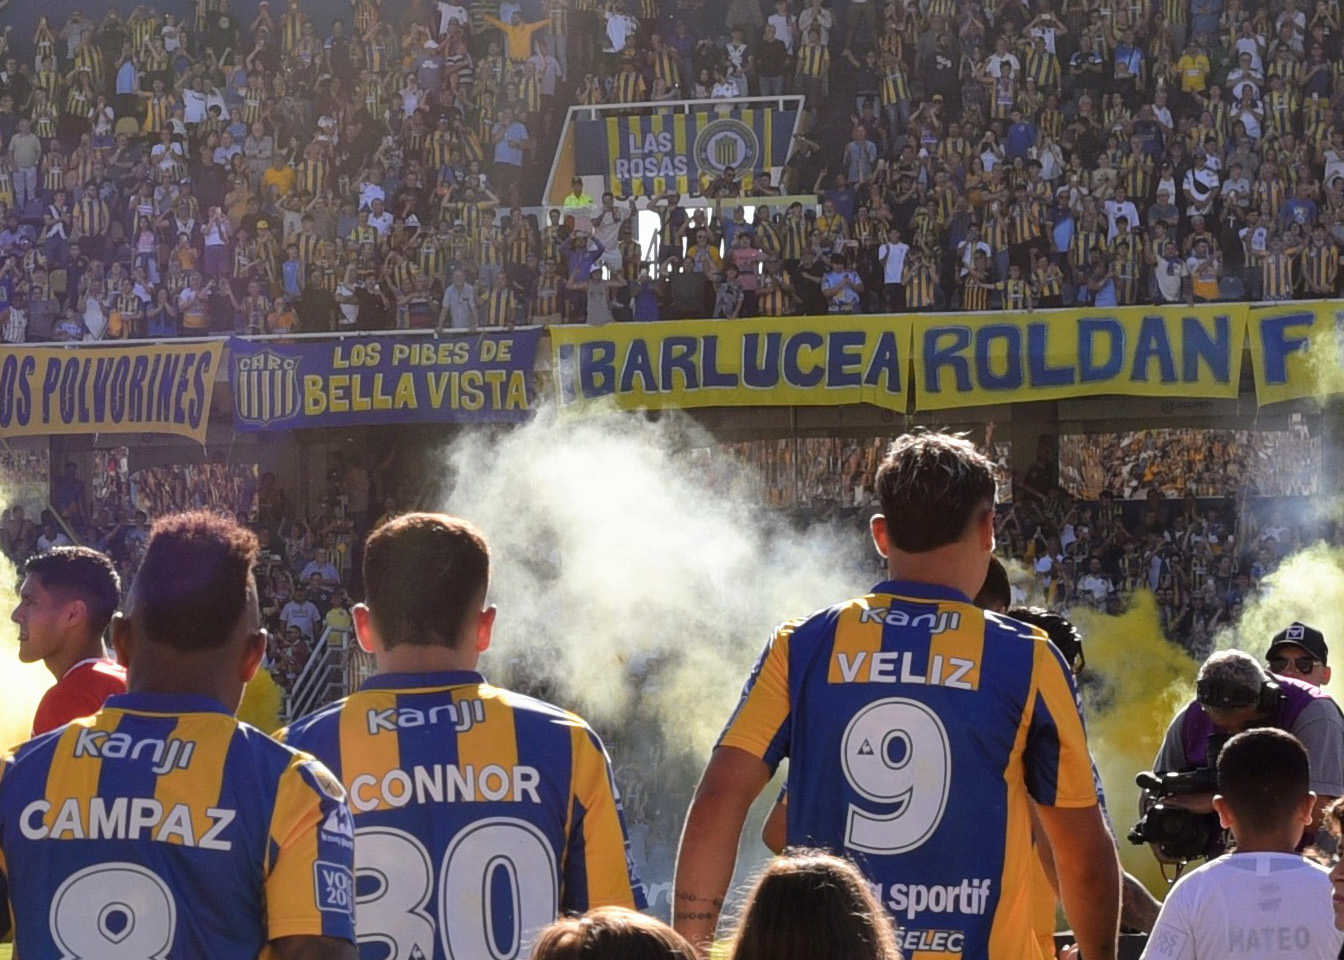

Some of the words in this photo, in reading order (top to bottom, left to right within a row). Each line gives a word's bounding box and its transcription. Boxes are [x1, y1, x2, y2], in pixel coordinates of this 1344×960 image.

[629, 132, 672, 154] LAS
[616, 156, 688, 179] ROSAS
[333, 342, 381, 368] LOS
[393, 339, 469, 366] PIBES
[479, 340, 513, 362] DE
[922, 314, 1231, 392] ROLDAN
[42, 351, 212, 430] POLVORINES
[304, 372, 418, 415] BELLA
[427, 370, 529, 410] VISTA
[837, 652, 974, 690] VELIZ
[351, 765, 541, 812] CONNOR
[840, 697, 951, 855] 9
[19, 797, 236, 850] CAMPAZ
[888, 879, 991, 919] sportif
[1228, 926, 1310, 952] MATEO
